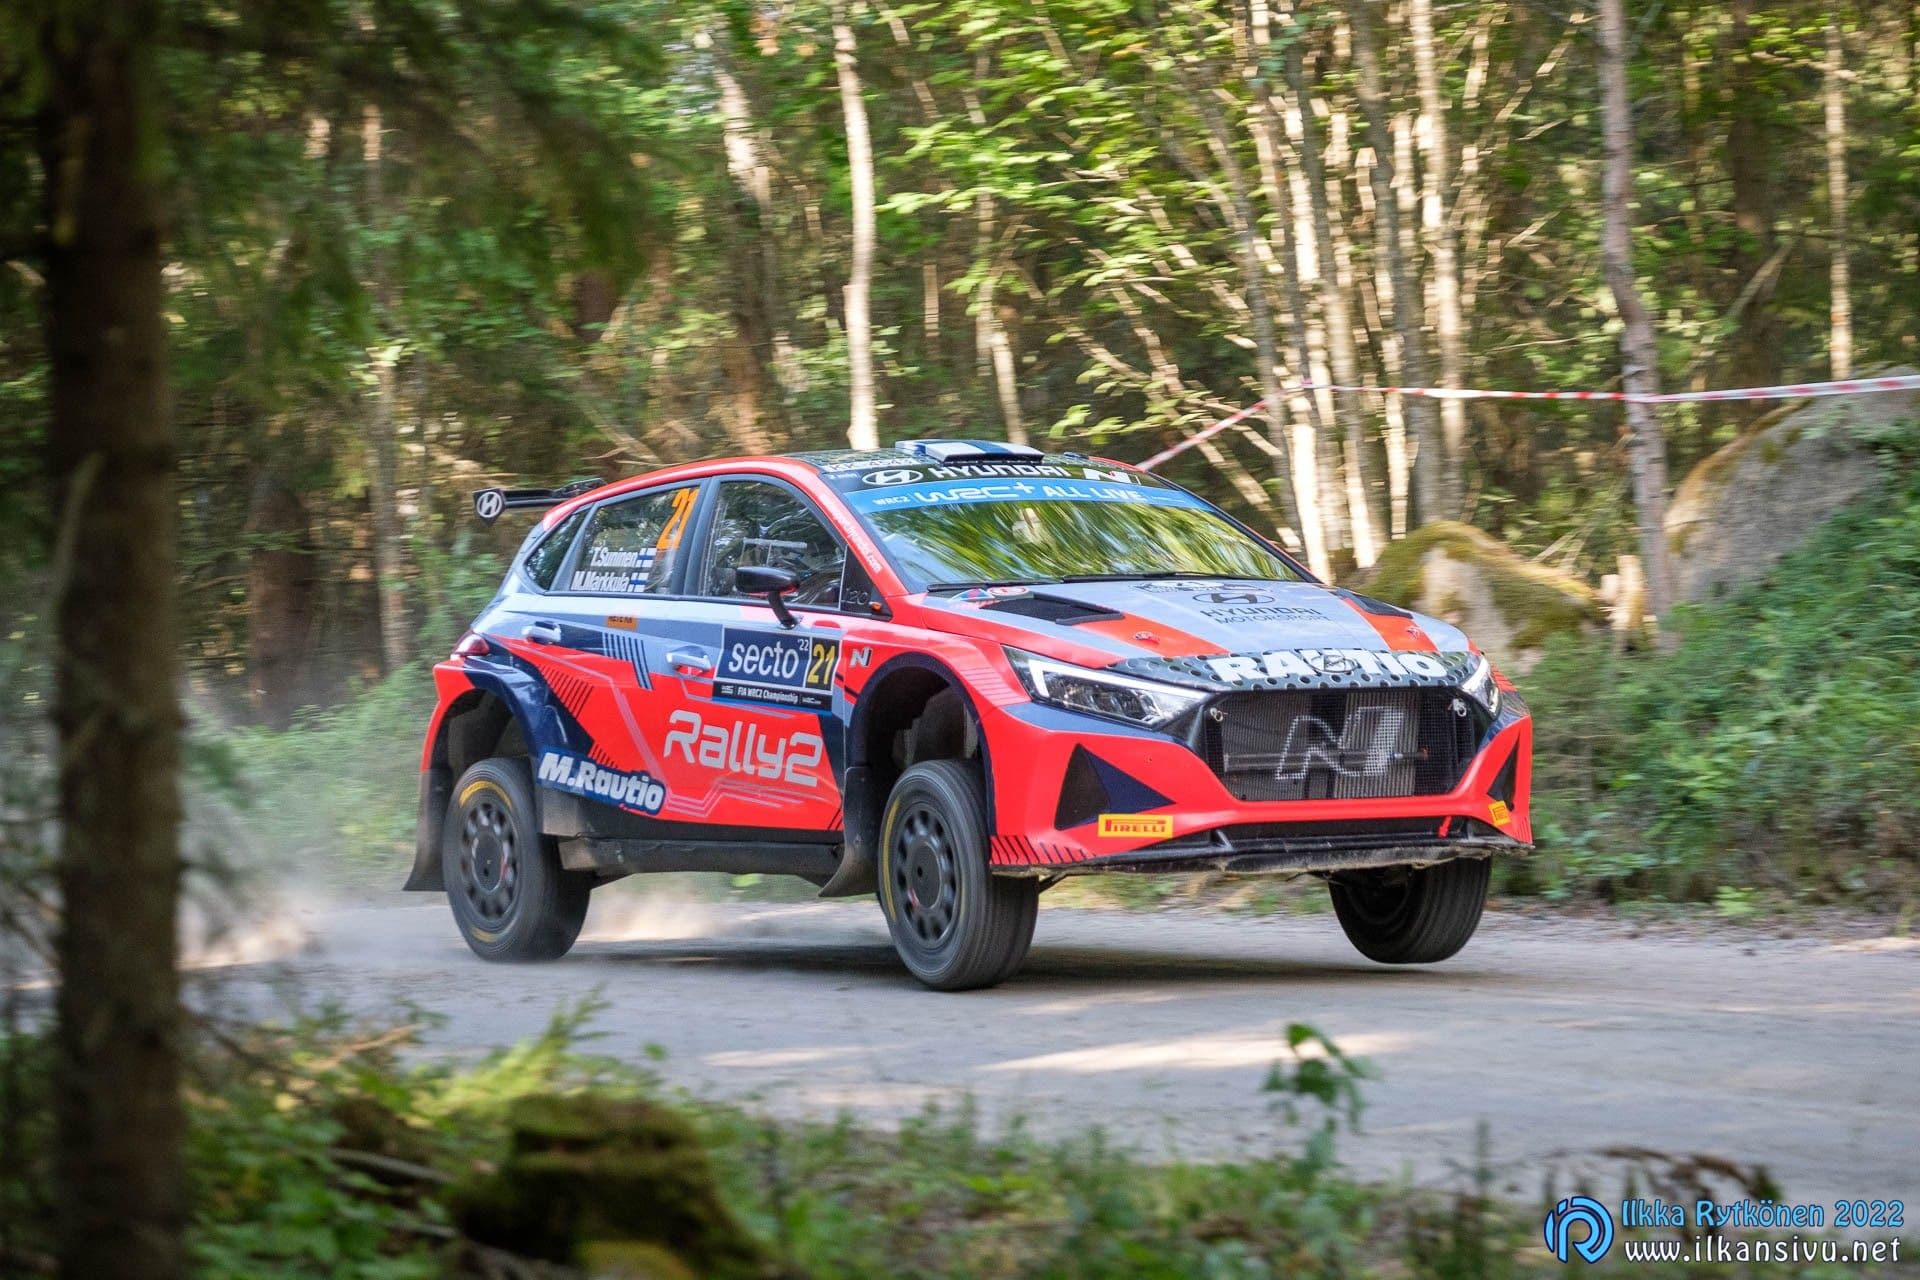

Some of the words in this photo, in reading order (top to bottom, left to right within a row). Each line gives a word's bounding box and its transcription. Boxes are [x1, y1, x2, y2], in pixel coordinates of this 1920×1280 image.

[928, 464, 1072, 478] HYUNDAI
[1042, 485, 1086, 499] ALL
[1091, 487, 1148, 503] LIVE
[656, 487, 699, 550] 21
[590, 546, 639, 567] T.Suninen
[570, 570, 630, 592] M.Markkula
[1199, 607, 1323, 618] HYUNDAI
[1214, 614, 1333, 625] MOTORSPORT
[728, 640, 800, 680] secto
[806, 643, 836, 685] 21
[664, 709, 823, 788] Rally2
[538, 752, 666, 811] M.Rautio
[1105, 819, 1167, 833] PIRELLI
